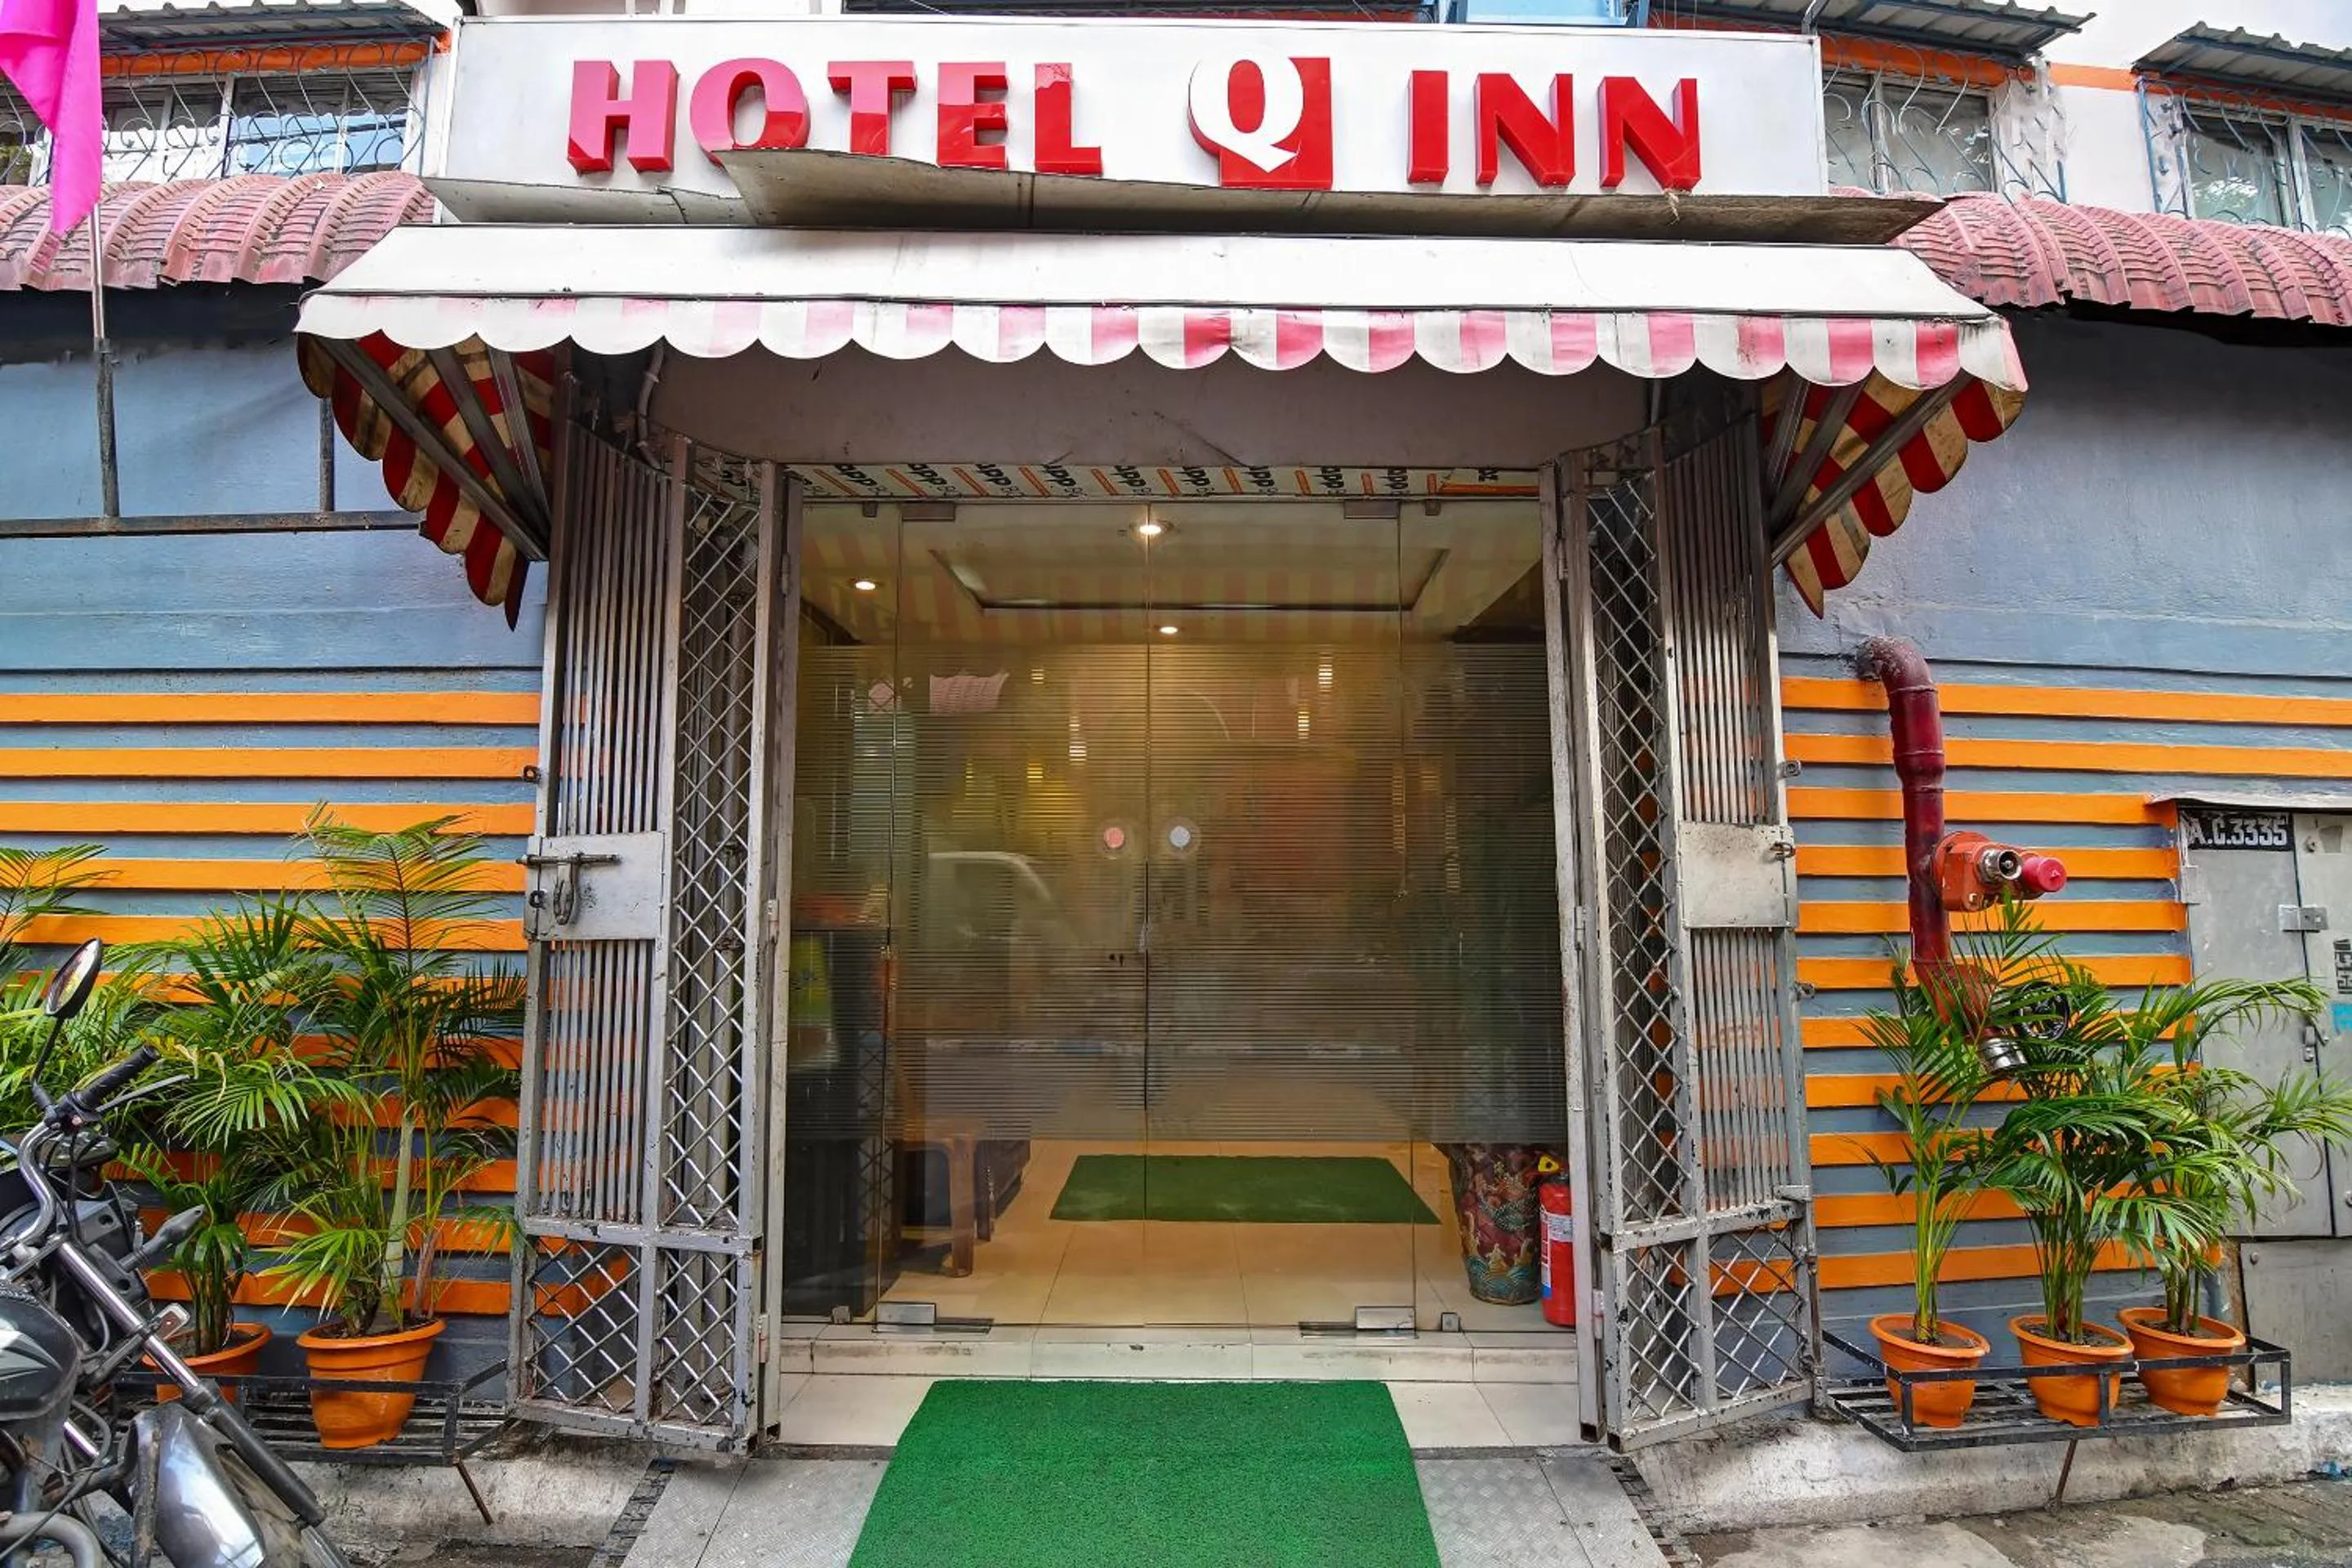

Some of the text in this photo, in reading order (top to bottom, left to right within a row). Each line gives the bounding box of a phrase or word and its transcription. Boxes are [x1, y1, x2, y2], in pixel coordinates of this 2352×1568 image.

[568, 52, 1702, 192] HOTEL Q INN
